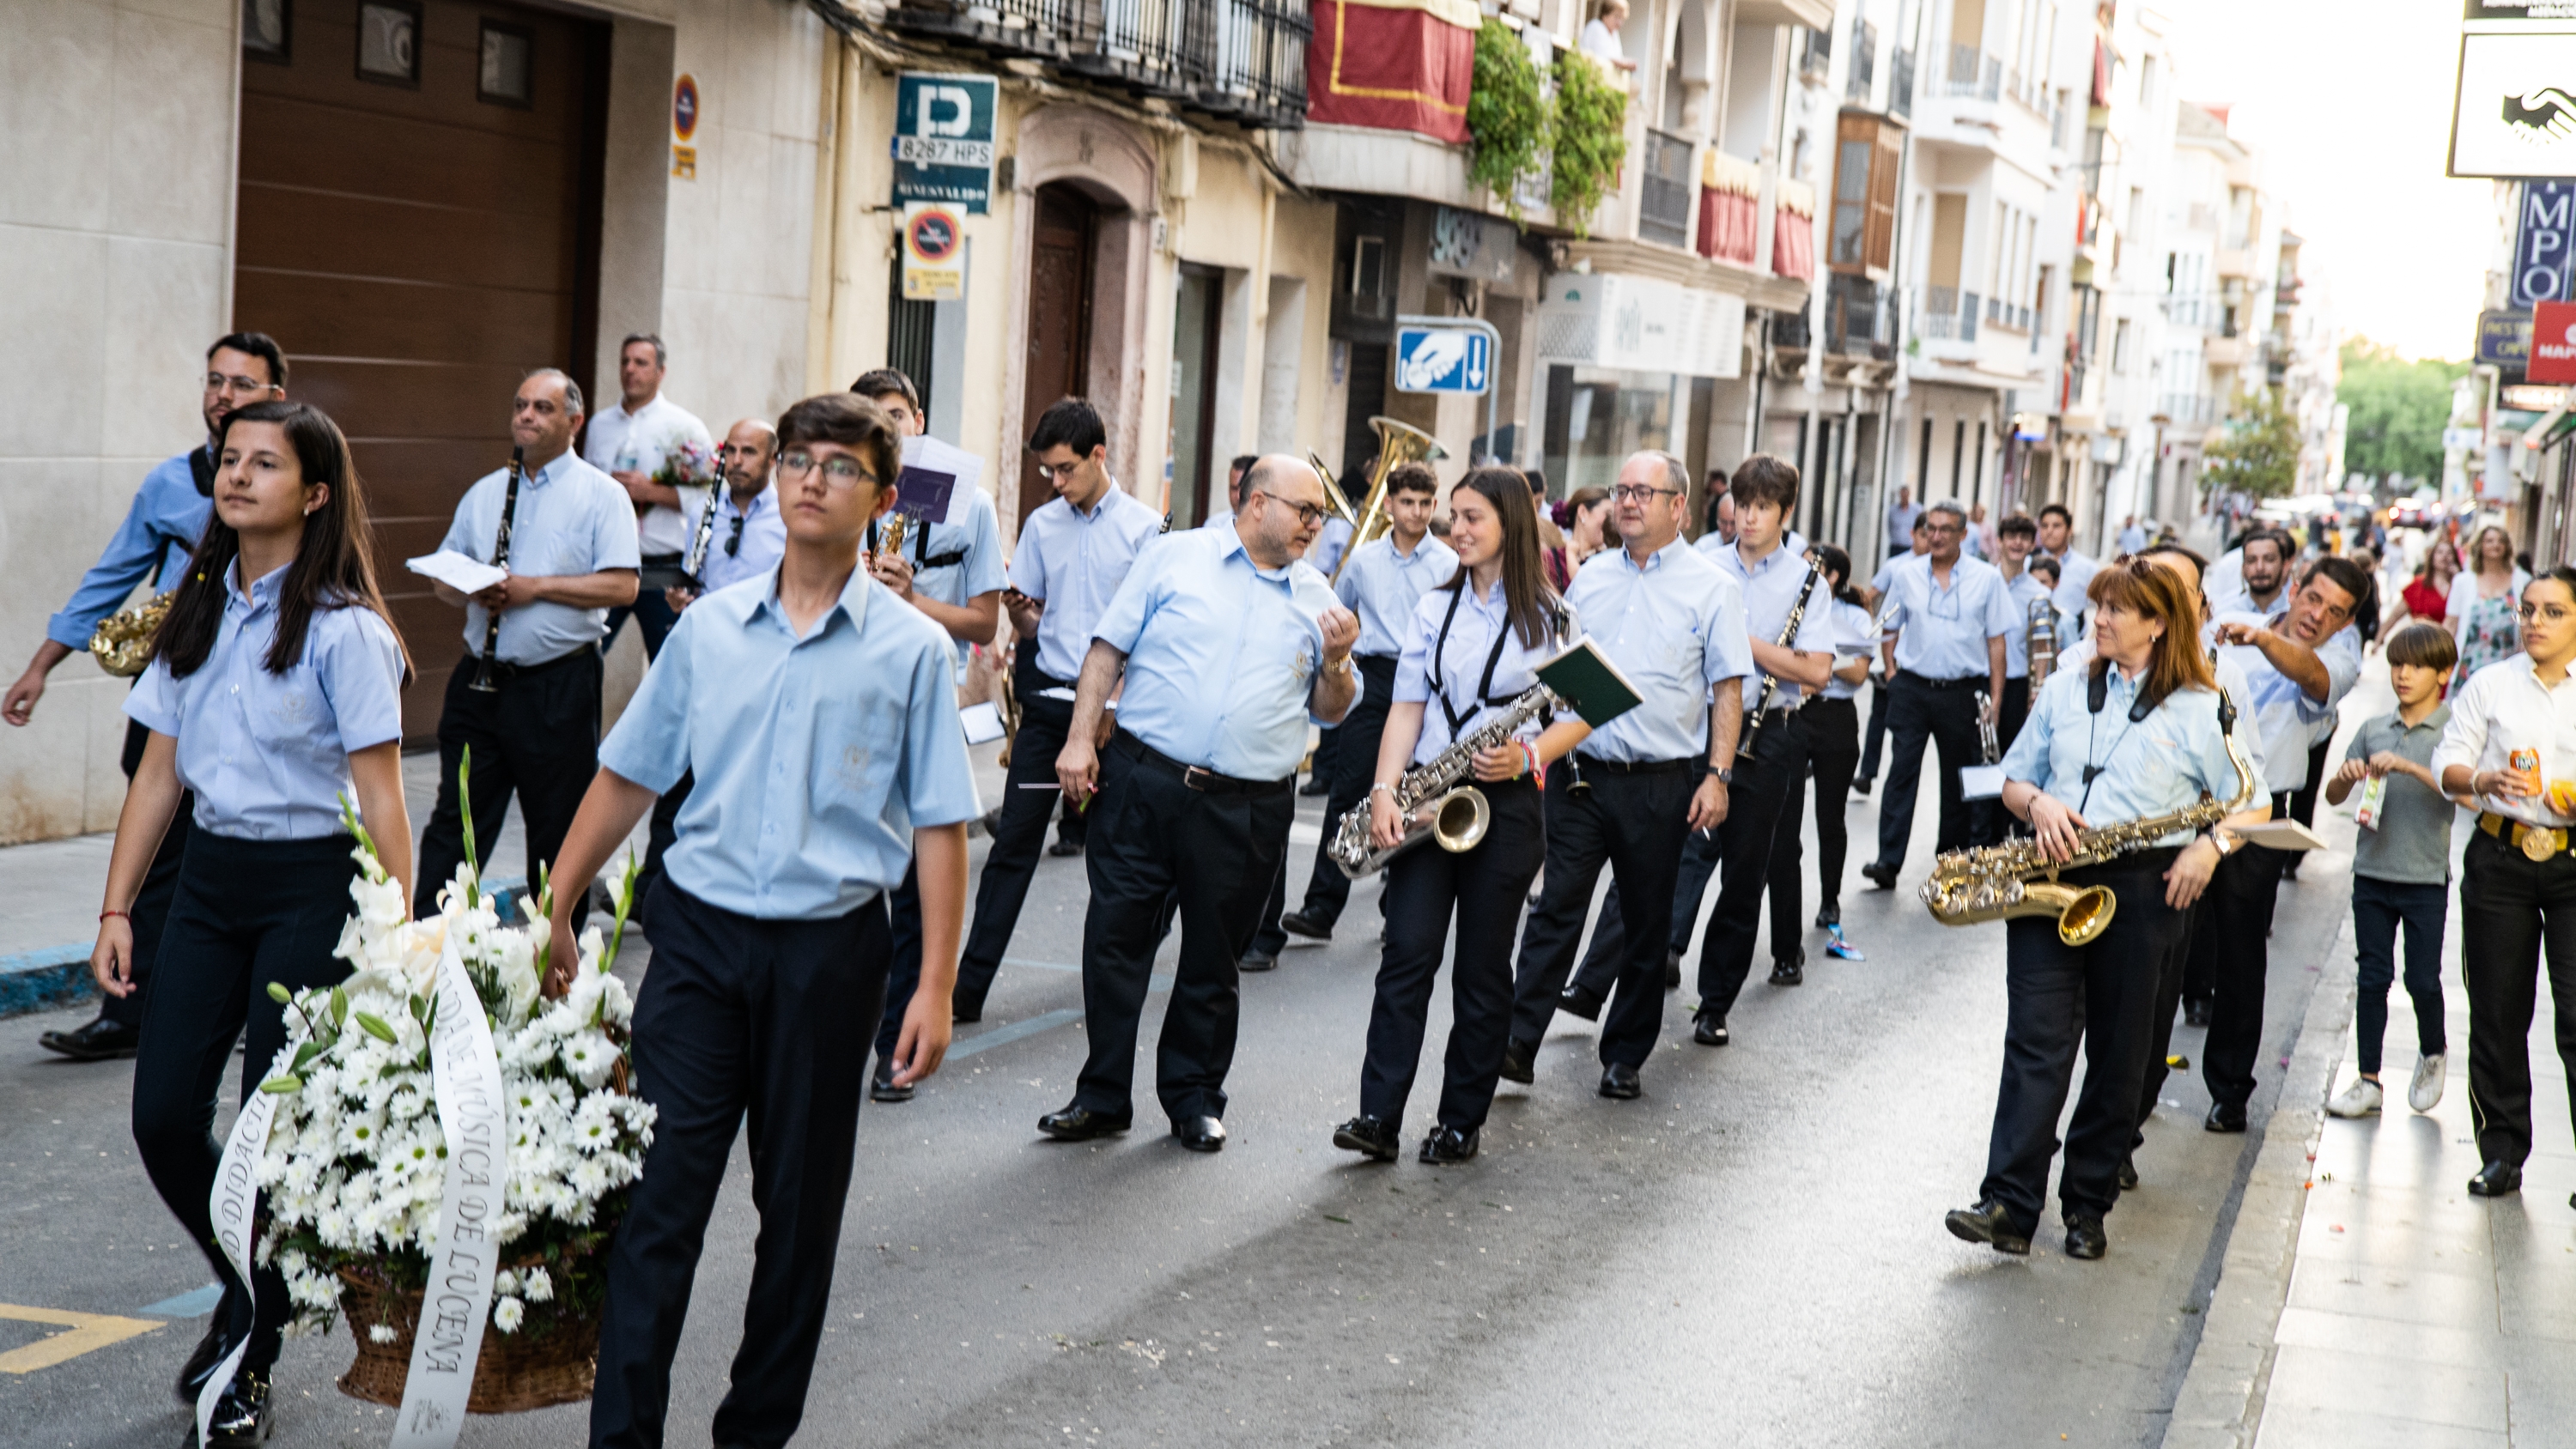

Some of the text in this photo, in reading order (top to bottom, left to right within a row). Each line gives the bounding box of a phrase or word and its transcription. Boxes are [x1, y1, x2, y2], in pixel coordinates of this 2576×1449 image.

[917, 84, 972, 170] P
[902, 140, 990, 163] 8287 HPS
[2538, 343, 2576, 359] MAP
[447, 1034, 477, 1082] DE
[452, 1070, 499, 1187] MÚSICA
[453, 1194, 488, 1242] DE
[424, 1248, 481, 1375] LUCENA
